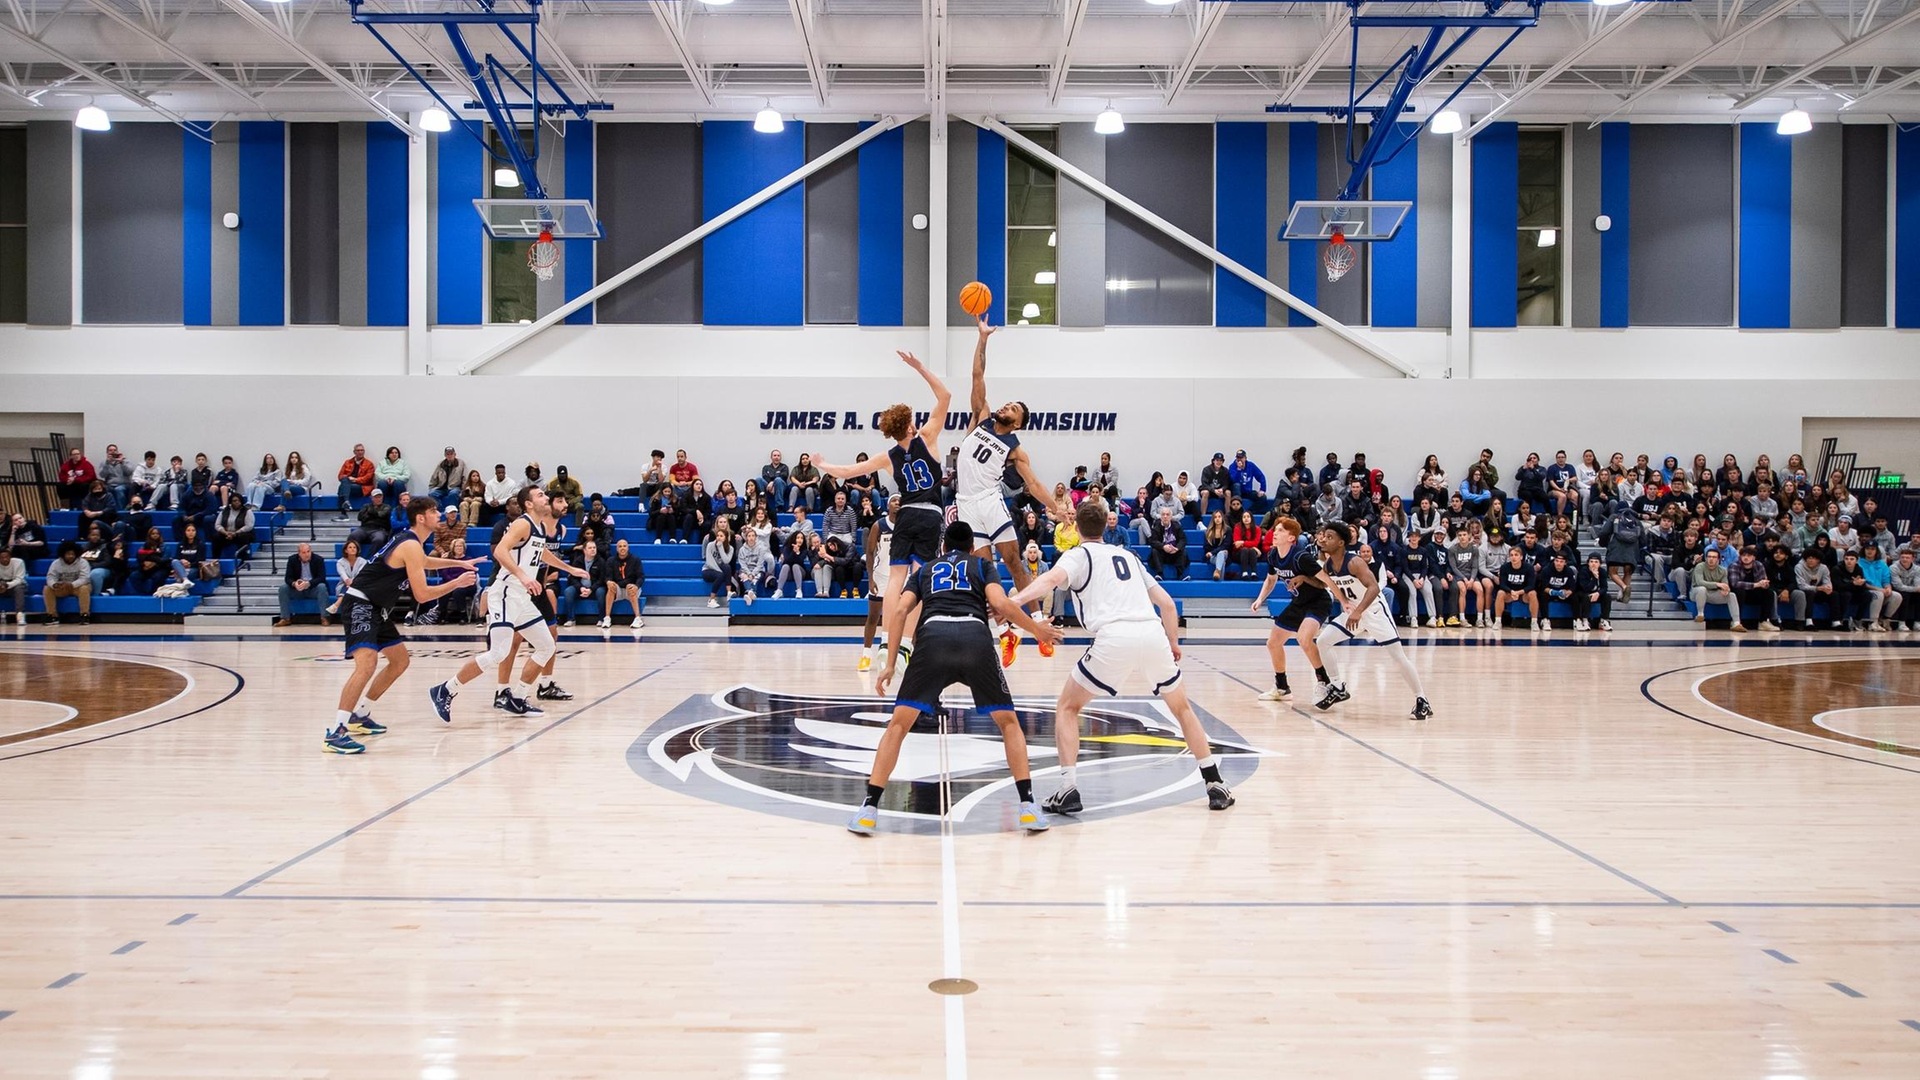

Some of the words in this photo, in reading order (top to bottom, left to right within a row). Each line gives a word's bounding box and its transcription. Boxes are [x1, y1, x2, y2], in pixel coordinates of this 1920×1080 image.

[760, 411, 836, 430] JAMES
[843, 411, 864, 430] A.
[872, 411, 973, 430] CHUN
[1022, 411, 1117, 431] NASIUM
[974, 431, 991, 443] BLUE
[990, 442, 1006, 455] JAYS
[972, 443, 993, 464] 10
[902, 458, 934, 492] 13
[1643, 503, 1659, 512] USJ
[1457, 552, 1472, 562] USJ
[931, 559, 972, 594] 21
[1111, 555, 1132, 581] 0
[1507, 574, 1525, 583] USJ
[1549, 576, 1569, 586] USJ
